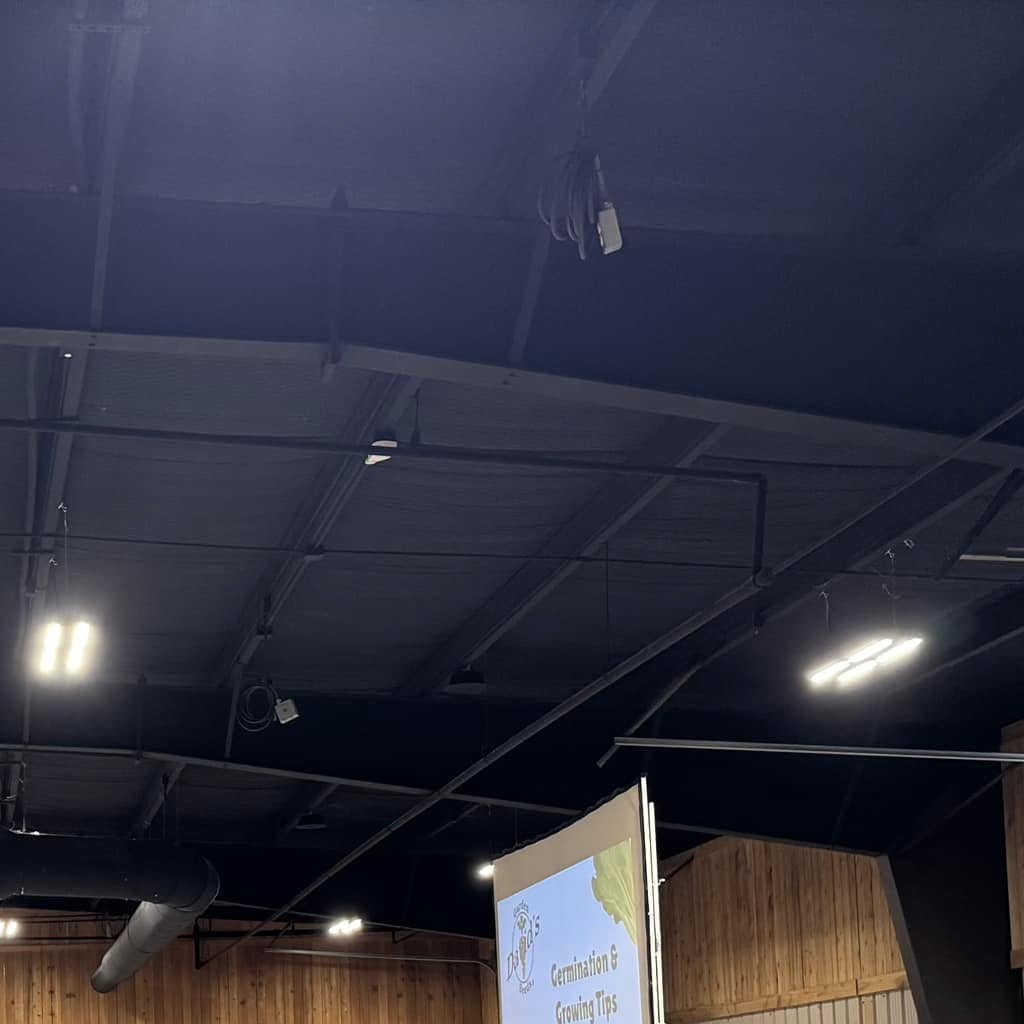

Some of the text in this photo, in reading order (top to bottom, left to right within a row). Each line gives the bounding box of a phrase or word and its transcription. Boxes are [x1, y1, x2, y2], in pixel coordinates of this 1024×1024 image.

[551, 943, 618, 987] Germination &
[556, 989, 618, 1024] Growing Tips
